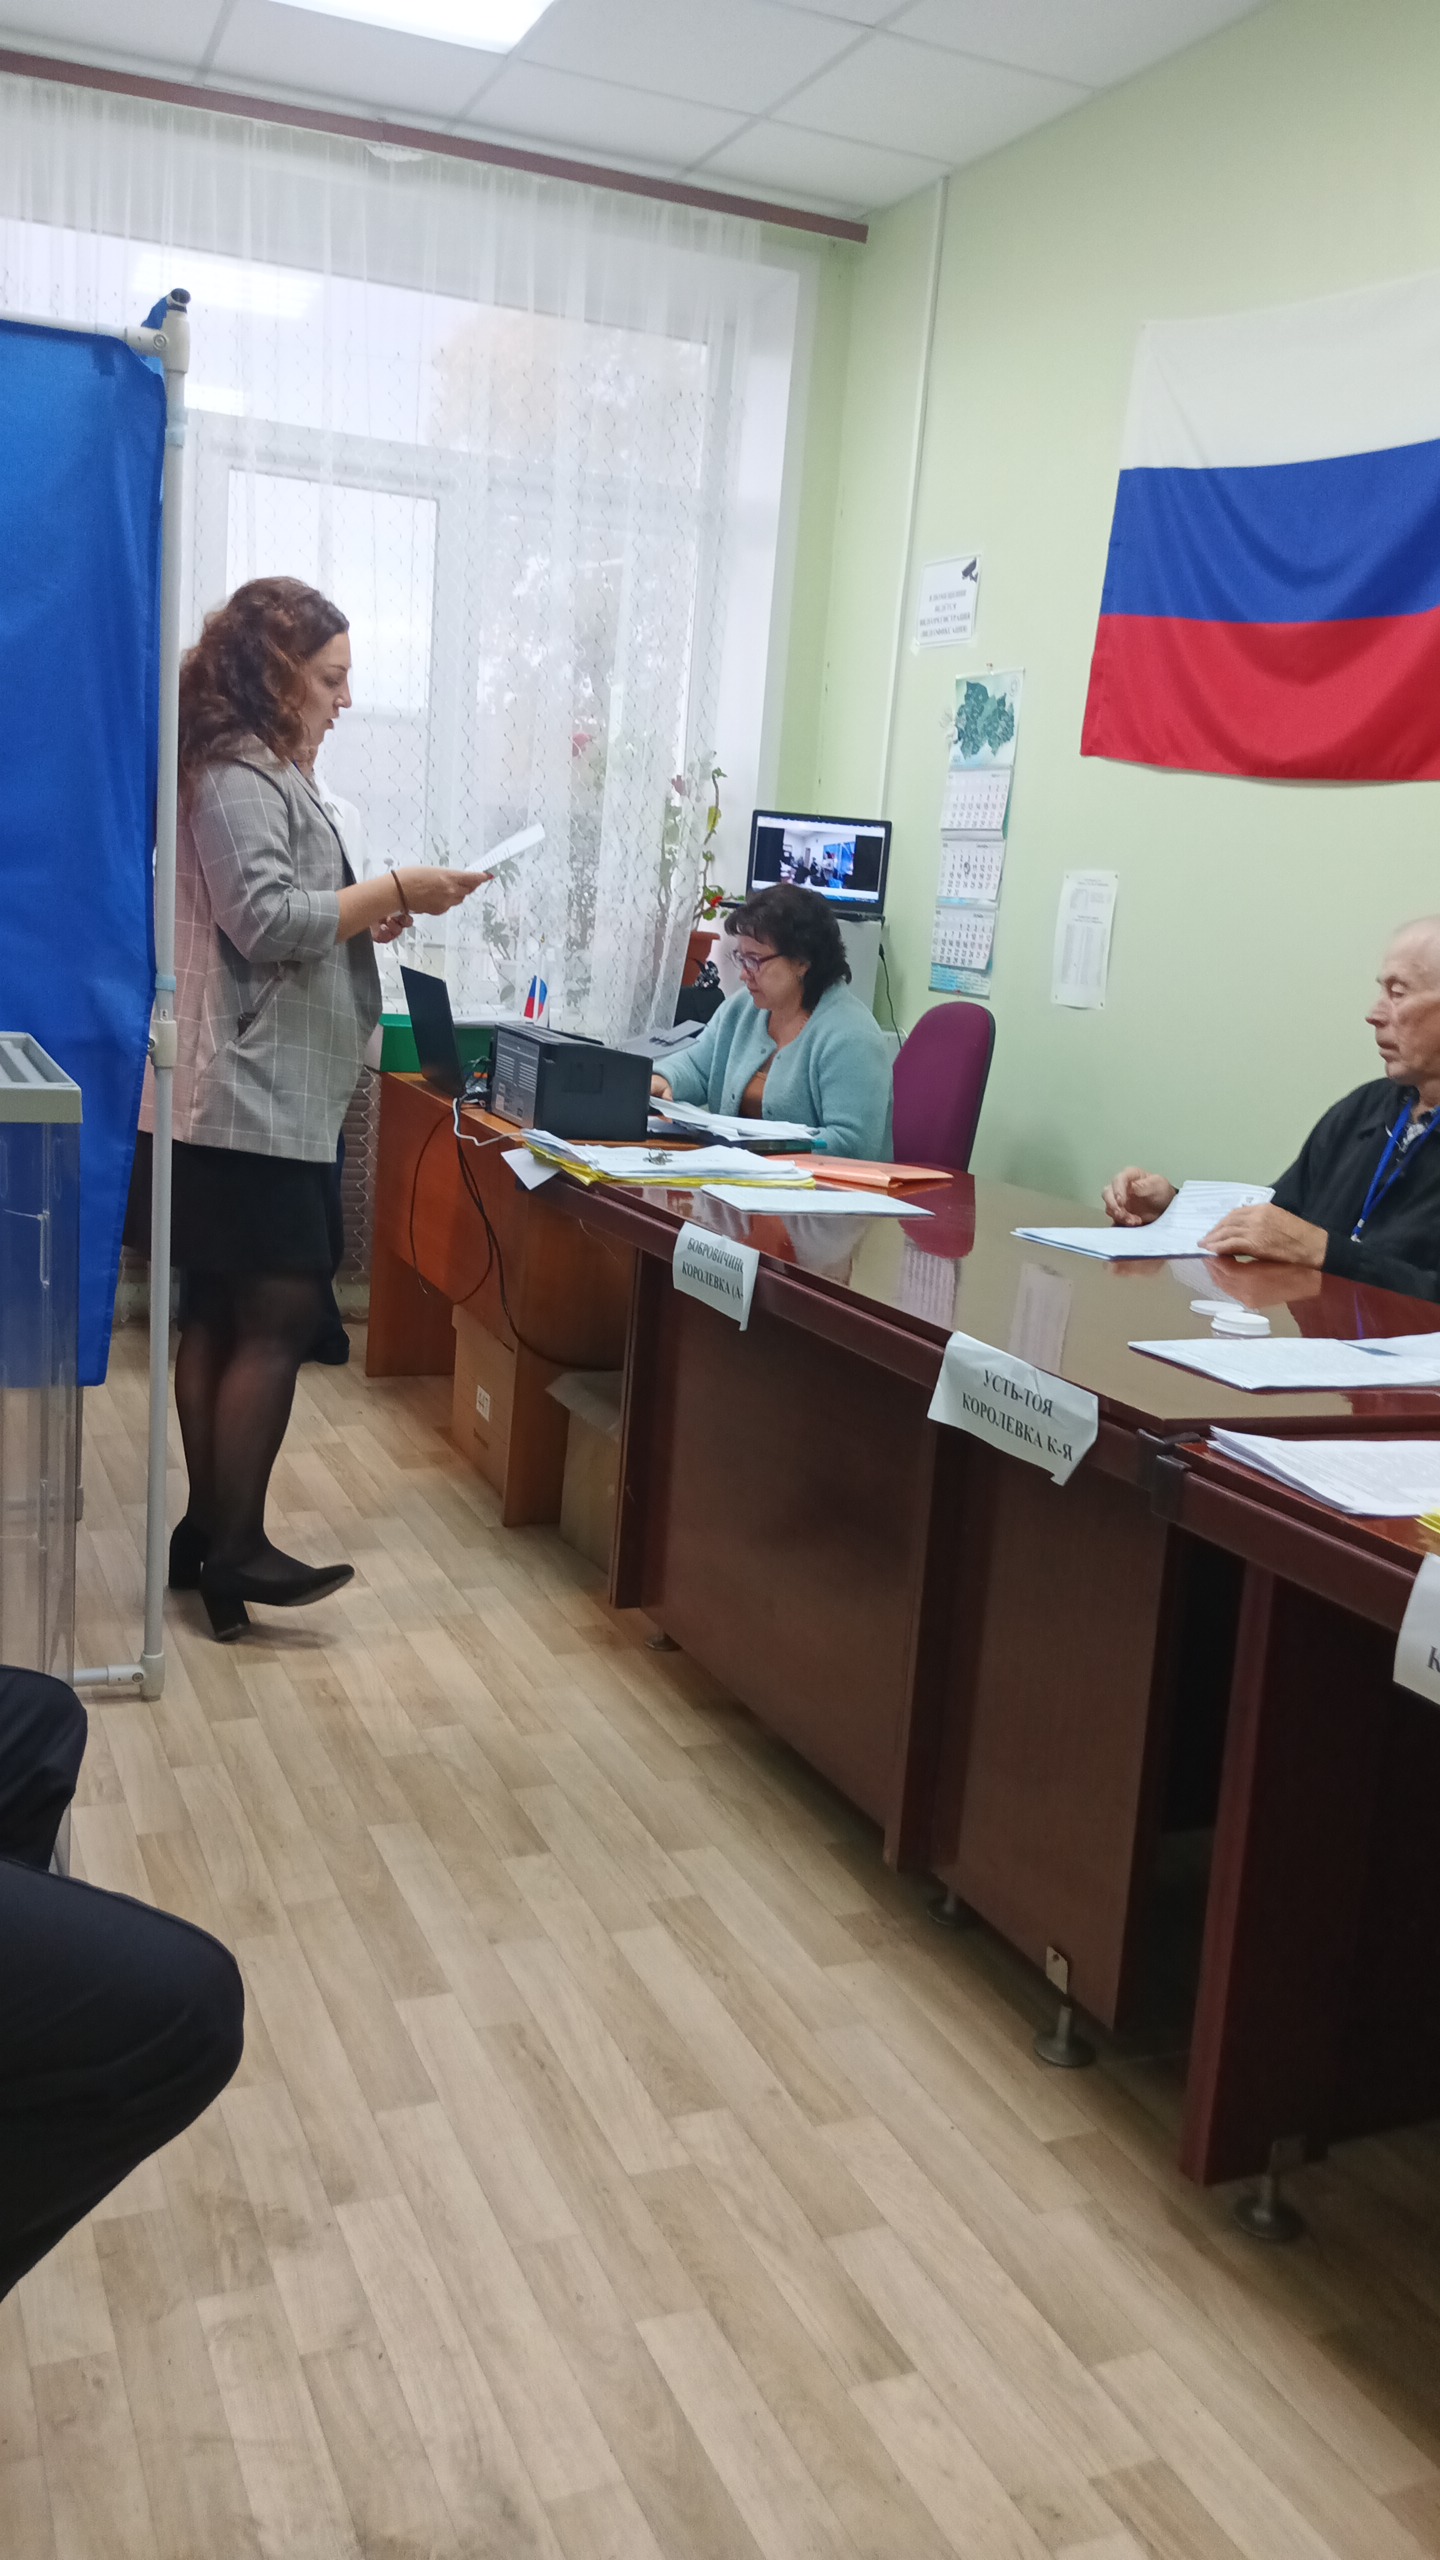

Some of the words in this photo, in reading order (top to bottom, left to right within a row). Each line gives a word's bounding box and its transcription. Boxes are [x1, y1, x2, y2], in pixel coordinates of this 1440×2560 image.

[682, 1260, 730, 1295] КОРОЛЕВКА
[983, 1369, 1053, 1418] УСТЬ-ТОЯ
[962, 1392, 1043, 1449] КОРОЛЕВКА
[1047, 1435, 1073, 1462] К-Я
